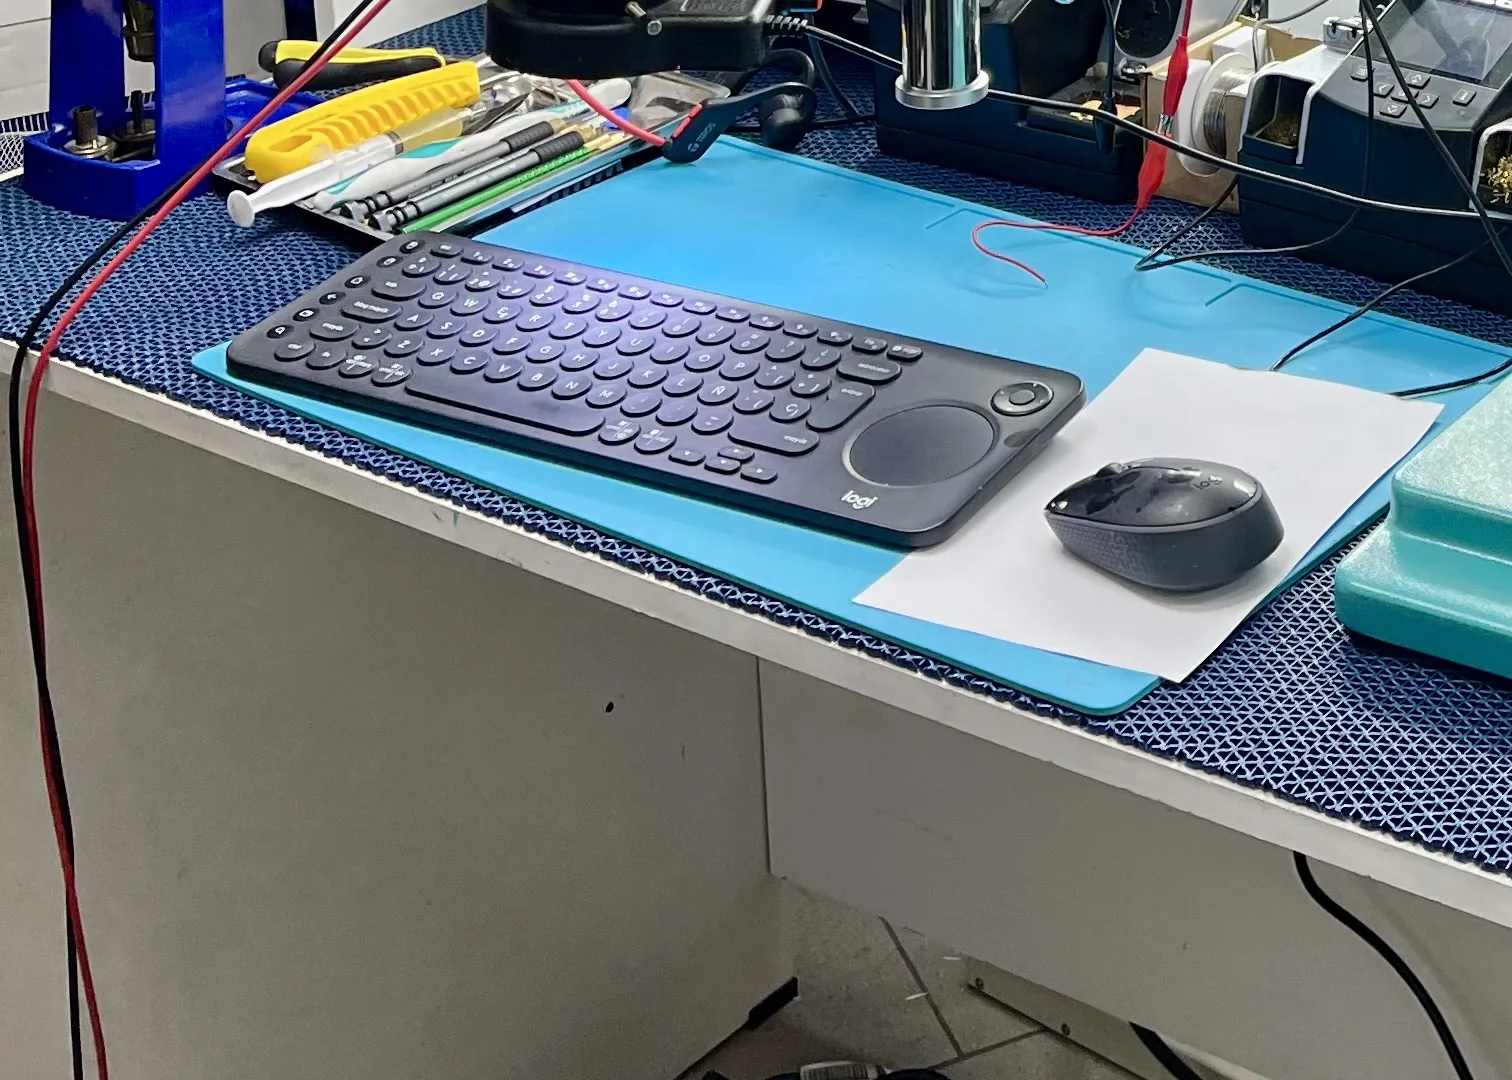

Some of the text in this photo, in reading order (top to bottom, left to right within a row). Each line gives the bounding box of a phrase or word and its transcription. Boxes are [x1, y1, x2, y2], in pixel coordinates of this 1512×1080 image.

[407, 313, 419, 322] A
[441, 321, 453, 330] S
[506, 337, 518, 345] F
[540, 346, 552, 354] G
[572, 353, 586, 362] H
[642, 370, 655, 378] K
[677, 378, 686, 386] L
[464, 299, 479, 307] W
[529, 314, 541, 323] R
[564, 322, 575, 330] T
[630, 338, 642, 346] U
[699, 354, 711, 362] O
[733, 362, 746, 371] P
[430, 347, 444, 357] X
[463, 357, 476, 365] C
[498, 364, 510, 373] V
[565, 381, 579, 390] N
[841, 490, 879, 510] logi
